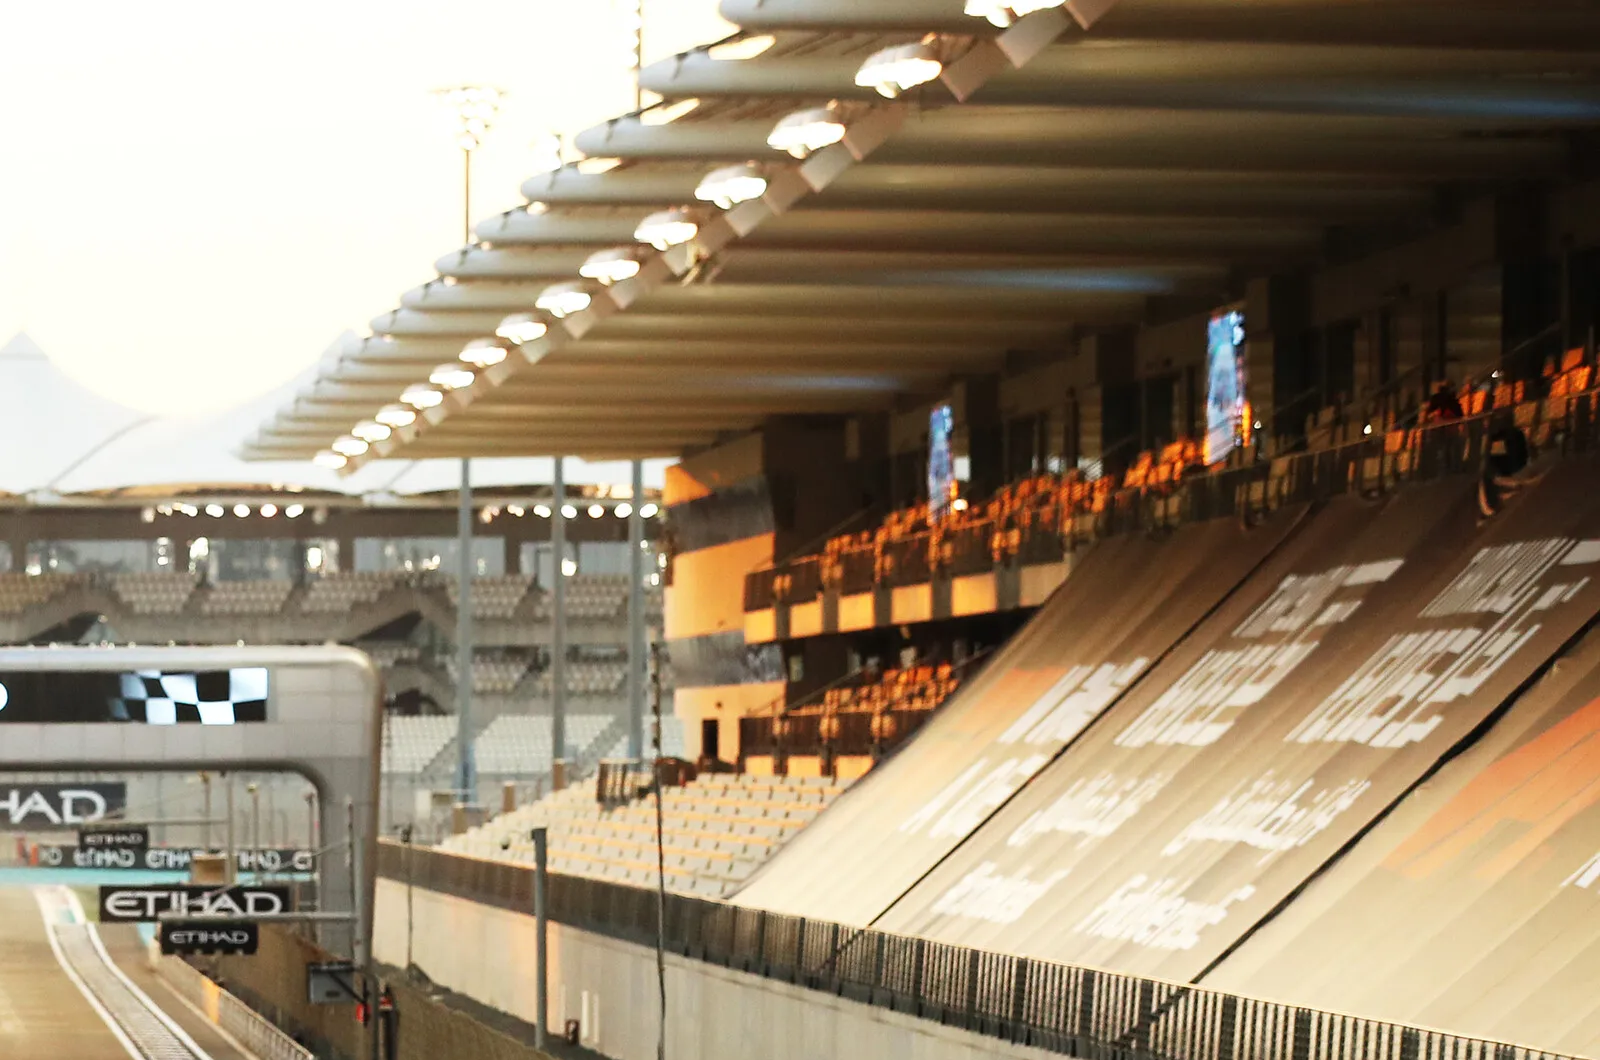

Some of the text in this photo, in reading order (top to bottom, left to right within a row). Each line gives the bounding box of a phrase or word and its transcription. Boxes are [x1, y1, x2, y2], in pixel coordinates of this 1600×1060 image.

[84, 833, 144, 844] ETIHAD
[105, 890, 283, 917] ETIHAD
[168, 930, 249, 945] ETIHAD
